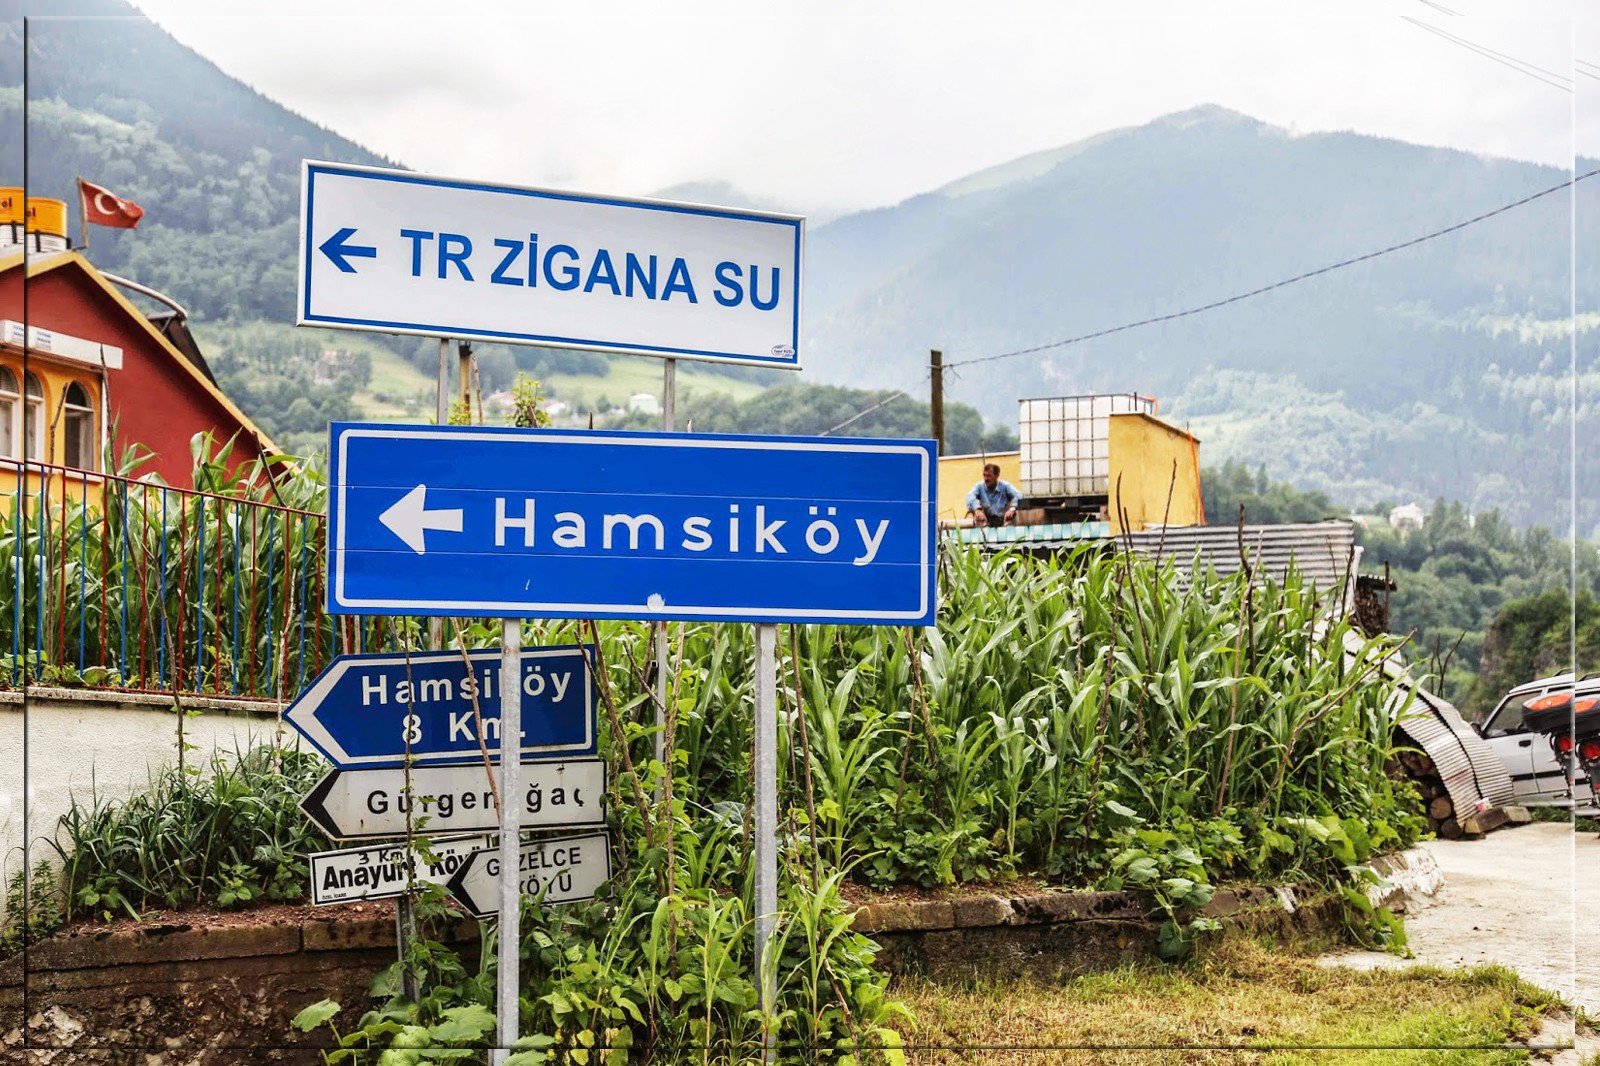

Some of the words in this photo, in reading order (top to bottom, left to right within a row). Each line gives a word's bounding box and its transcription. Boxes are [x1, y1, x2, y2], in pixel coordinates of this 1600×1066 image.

[401, 228, 474, 282] TR
[490, 232, 698, 304] ZİGANA
[713, 261, 780, 311] SU
[494, 497, 890, 566] Hamsiköy
[361, 665, 572, 706] Hamsiöy
[402, 714, 423, 745] 8
[367, 783, 585, 818] Gürgenğaç
[358, 851, 369, 865] 3
[486, 846, 582, 877] GZELCE
